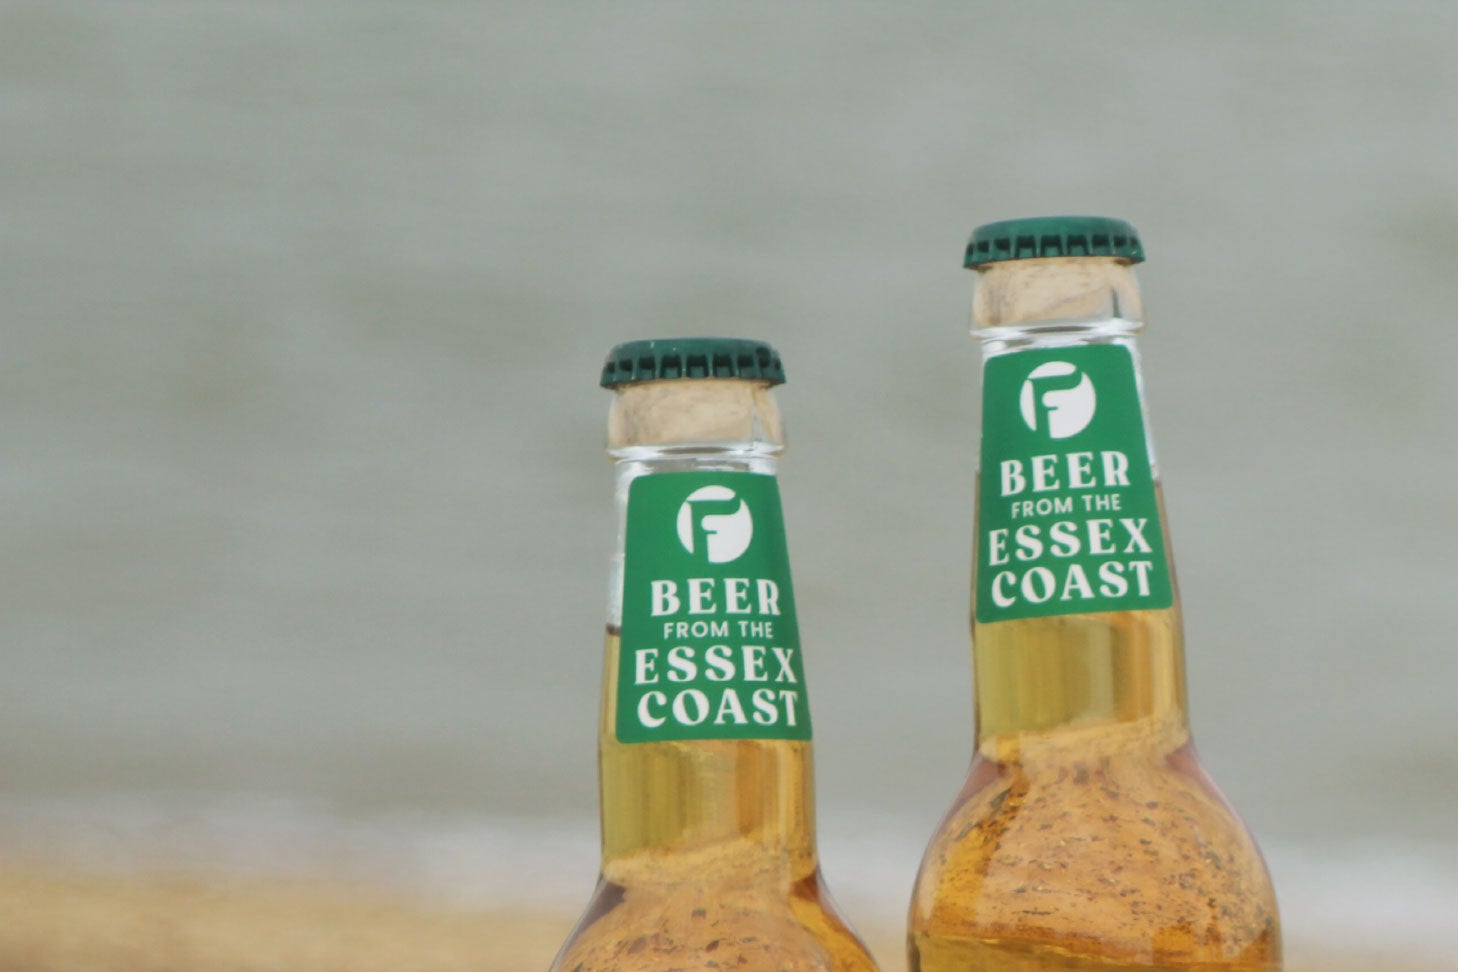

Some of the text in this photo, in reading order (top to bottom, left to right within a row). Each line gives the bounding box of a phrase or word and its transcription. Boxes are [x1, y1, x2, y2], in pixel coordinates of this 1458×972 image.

[1000, 451, 1130, 496] BEER
[1011, 494, 1121, 518] FROM THE
[988, 518, 1153, 566] ESSEX
[650, 578, 780, 616] BEER
[991, 561, 1153, 607] COAST
[663, 620, 774, 640] FROM THE
[634, 645, 797, 685] ESSEX
[637, 688, 798, 728] COAST
